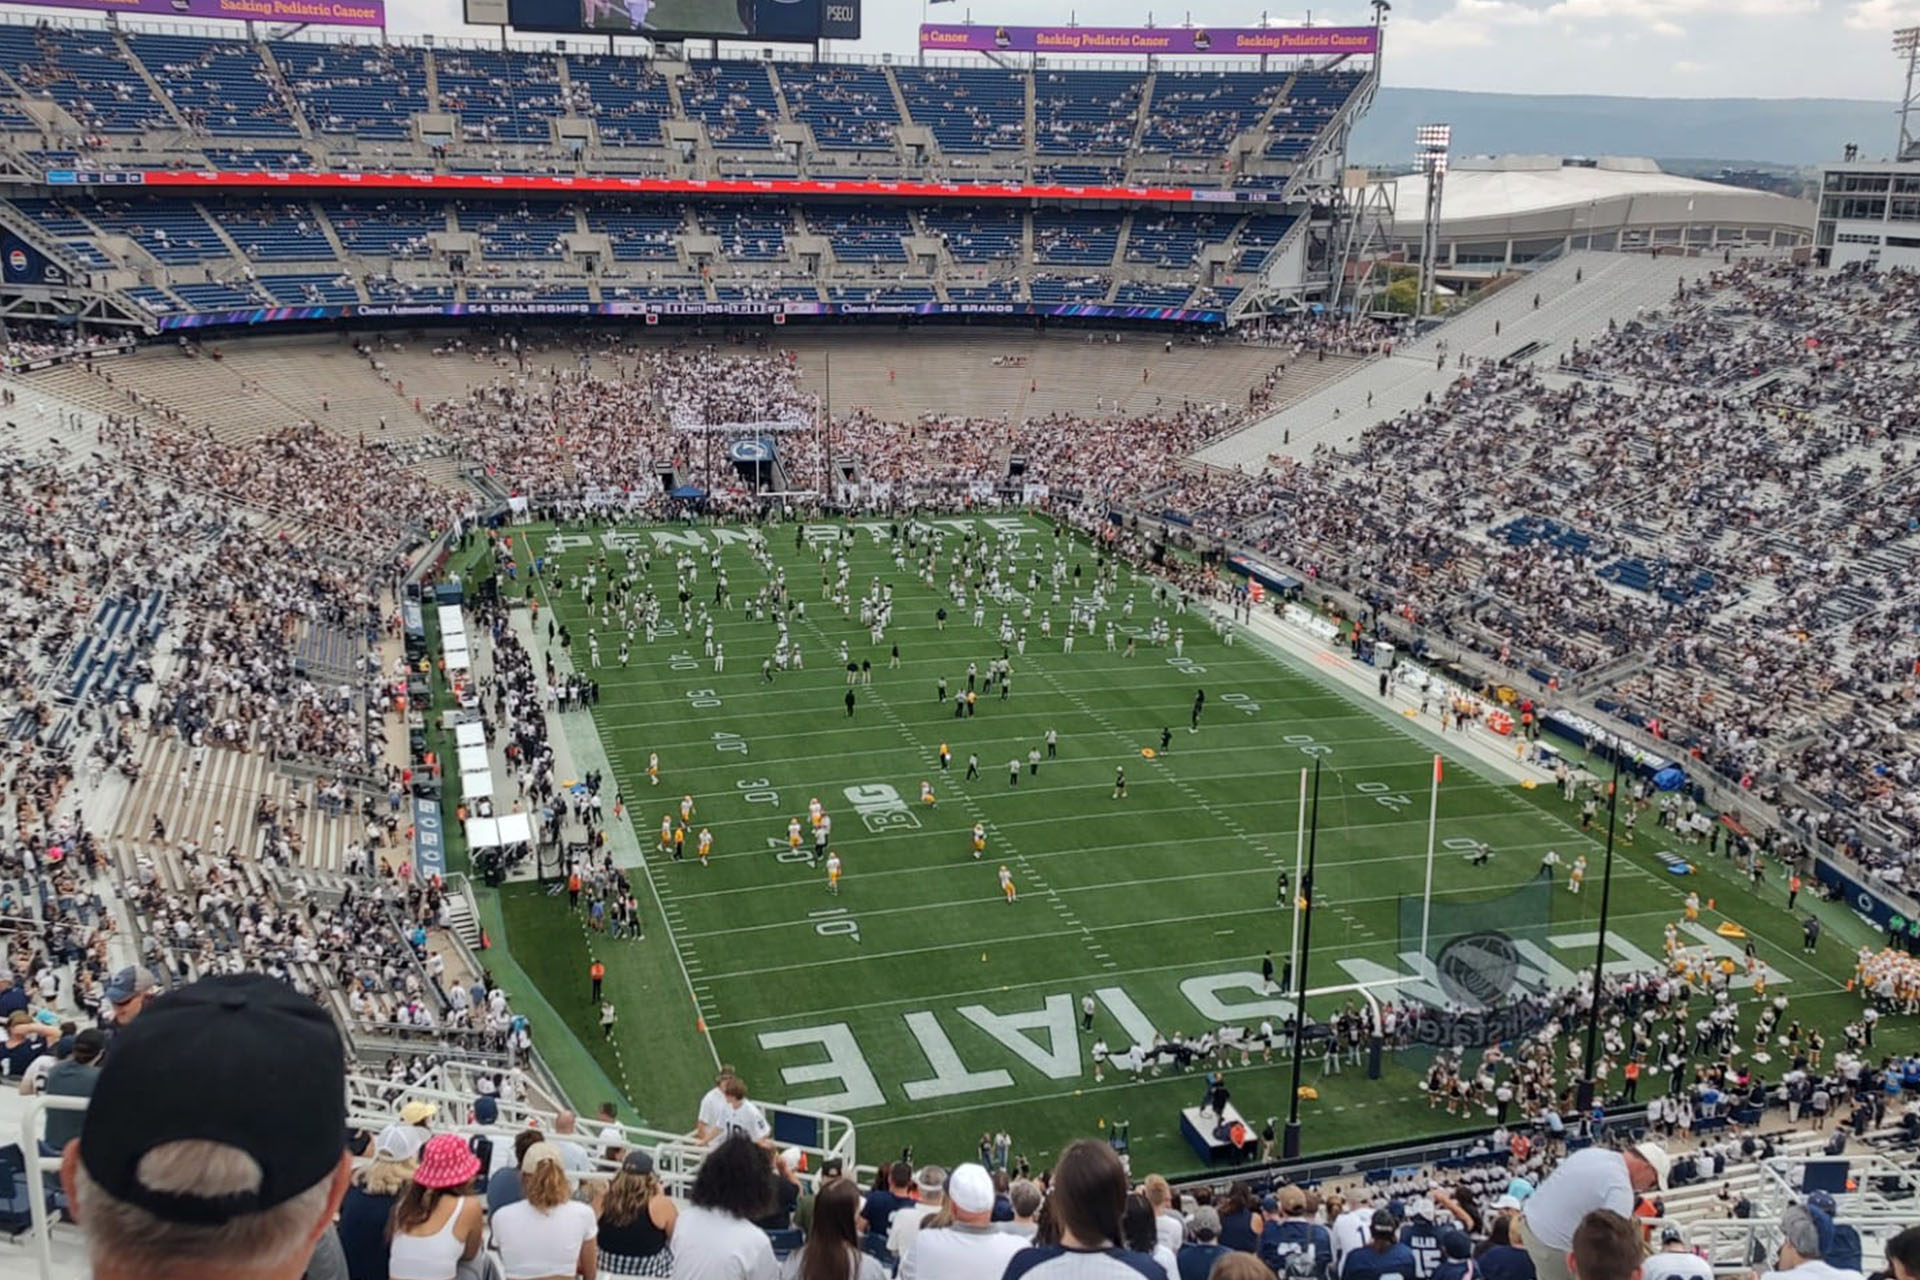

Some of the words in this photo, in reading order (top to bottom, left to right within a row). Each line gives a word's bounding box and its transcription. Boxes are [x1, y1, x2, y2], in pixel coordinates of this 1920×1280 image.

[221, 0, 272, 15] Sacking
[274, 1, 331, 17] Pediatric
[332, 4, 375, 18] Cancer
[827, 6, 853, 21] PSECU
[930, 31, 968, 43] Cancer
[1036, 33, 1080, 47] Sacking
[1082, 34, 1130, 46] Pediatric
[1132, 35, 1170, 46] Cancer
[1237, 35, 1280, 48] Sacking
[1282, 34, 1328, 46] Pediatric
[1330, 33, 1369, 45] Cancer
[490, 304, 590, 314] DEALERSHIPS
[961, 304, 1014, 313] BRANDS
[668, 654, 699, 671] 40
[1166, 657, 1207, 674] 50
[686, 688, 722, 708] 50
[1220, 693, 1261, 713] 40
[711, 731, 747, 752] 40
[1283, 734, 1333, 757] 30
[736, 777, 778, 803] 30
[1355, 782, 1412, 807] 20
[808, 908, 858, 935] 10
[757, 971, 1305, 1113] STATE
